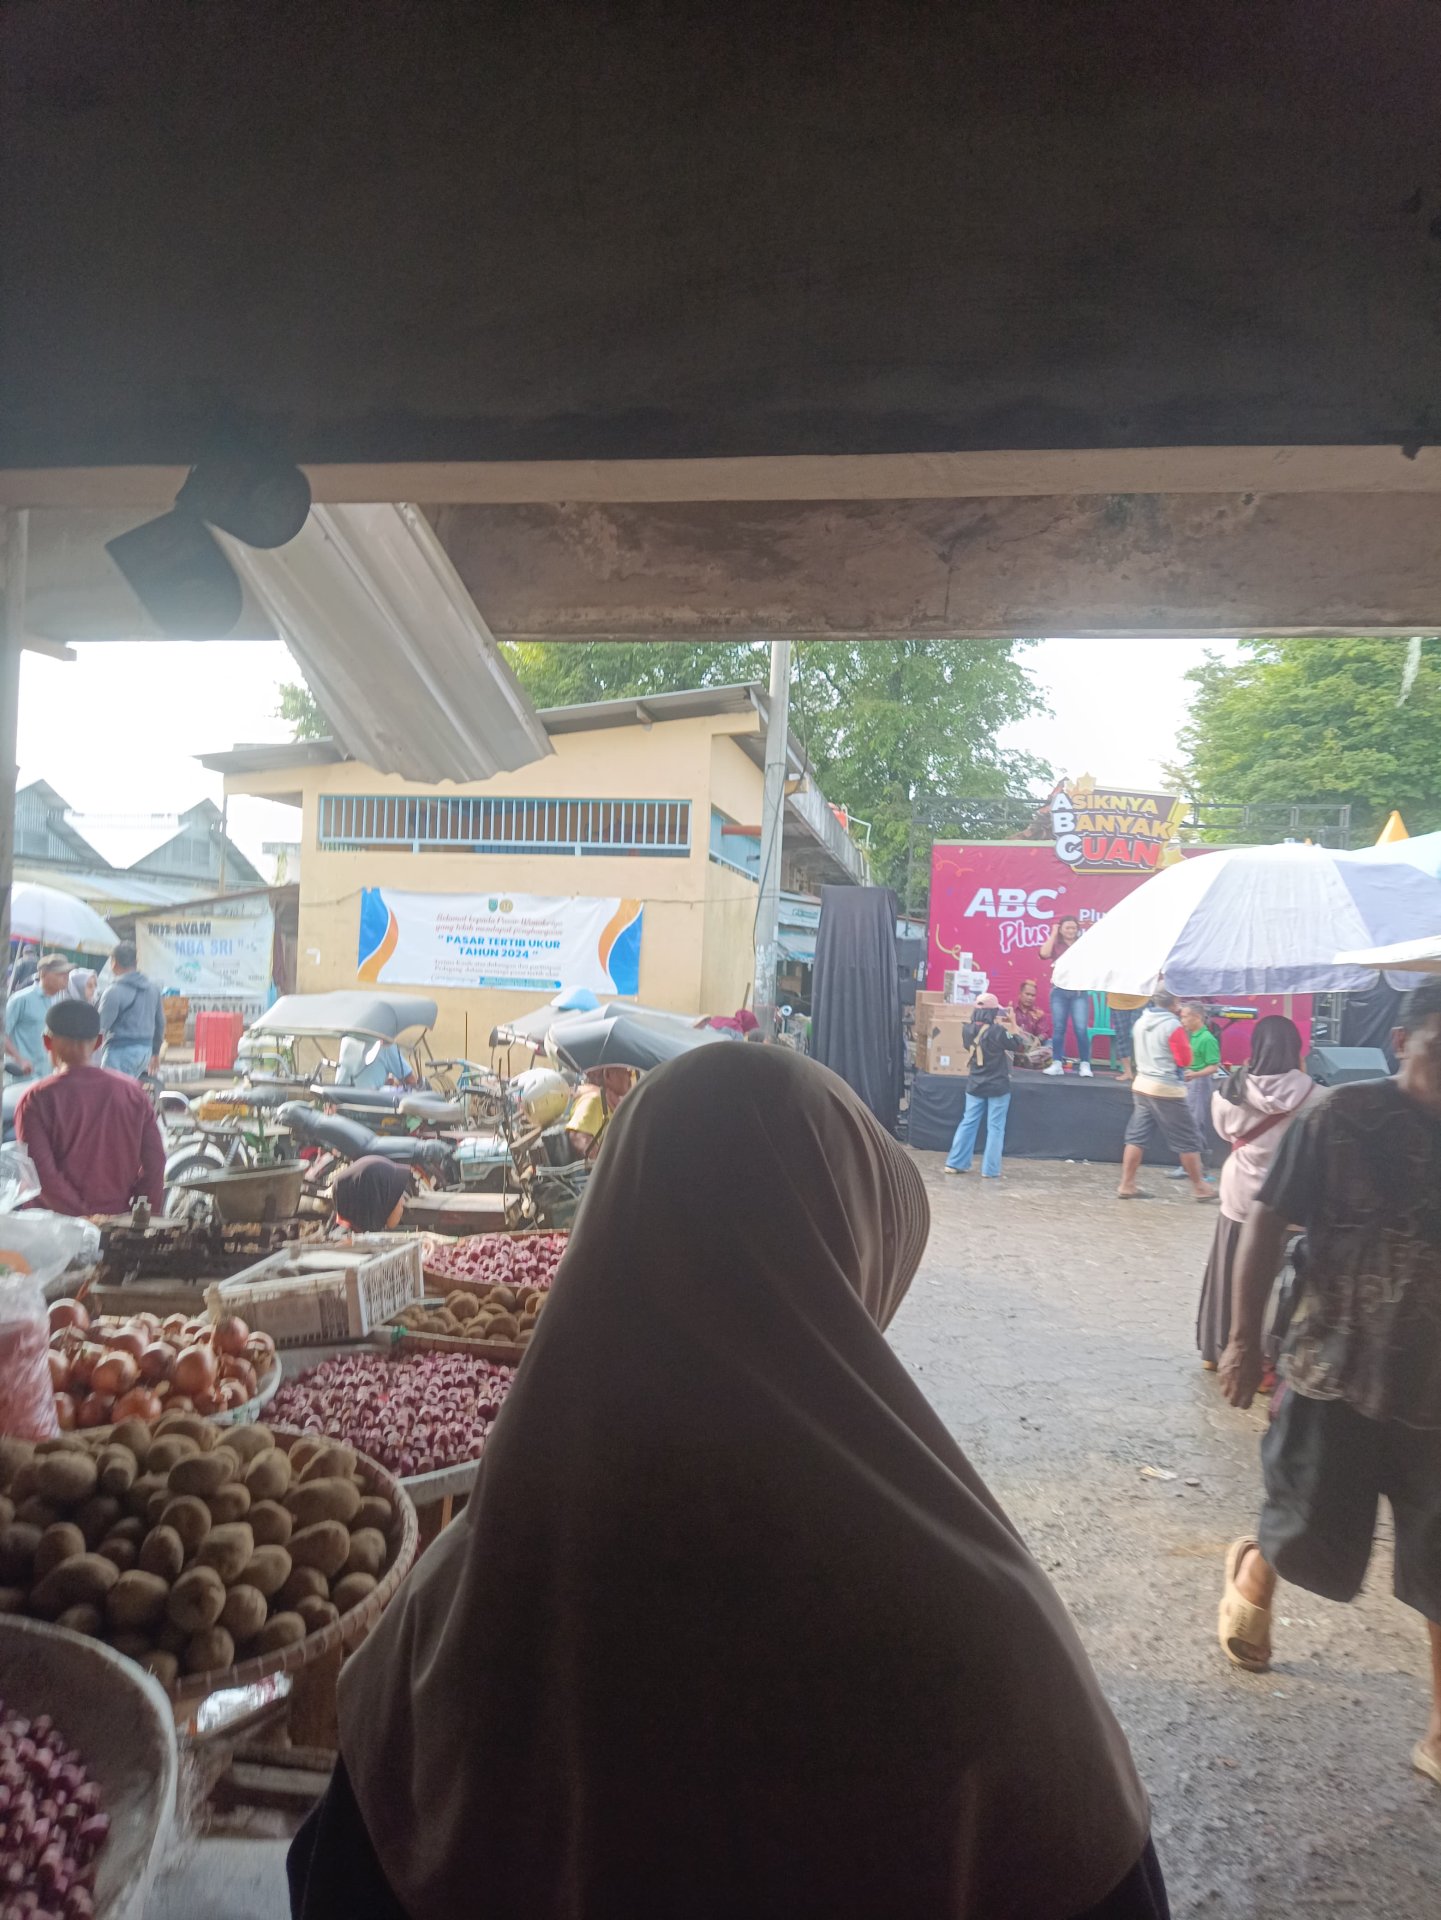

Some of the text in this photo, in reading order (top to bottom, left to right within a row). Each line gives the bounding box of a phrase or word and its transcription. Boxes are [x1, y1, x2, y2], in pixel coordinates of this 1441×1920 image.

[1051, 792, 1158, 814] ASIKNYA
[1053, 812, 1172, 839] BANYAK
[1056, 834, 1160, 867] CUAN
[963, 888, 1058, 919] ABC
[1079, 909, 1106, 921] Plu
[175, 921, 211, 936] AYAM
[999, 920, 1050, 953] Plus
[210, 939, 233, 956] SRI
[446, 935, 561, 949] PASAR TERTIB UKUR
[459, 946, 529, 959] TAHUN 2024
